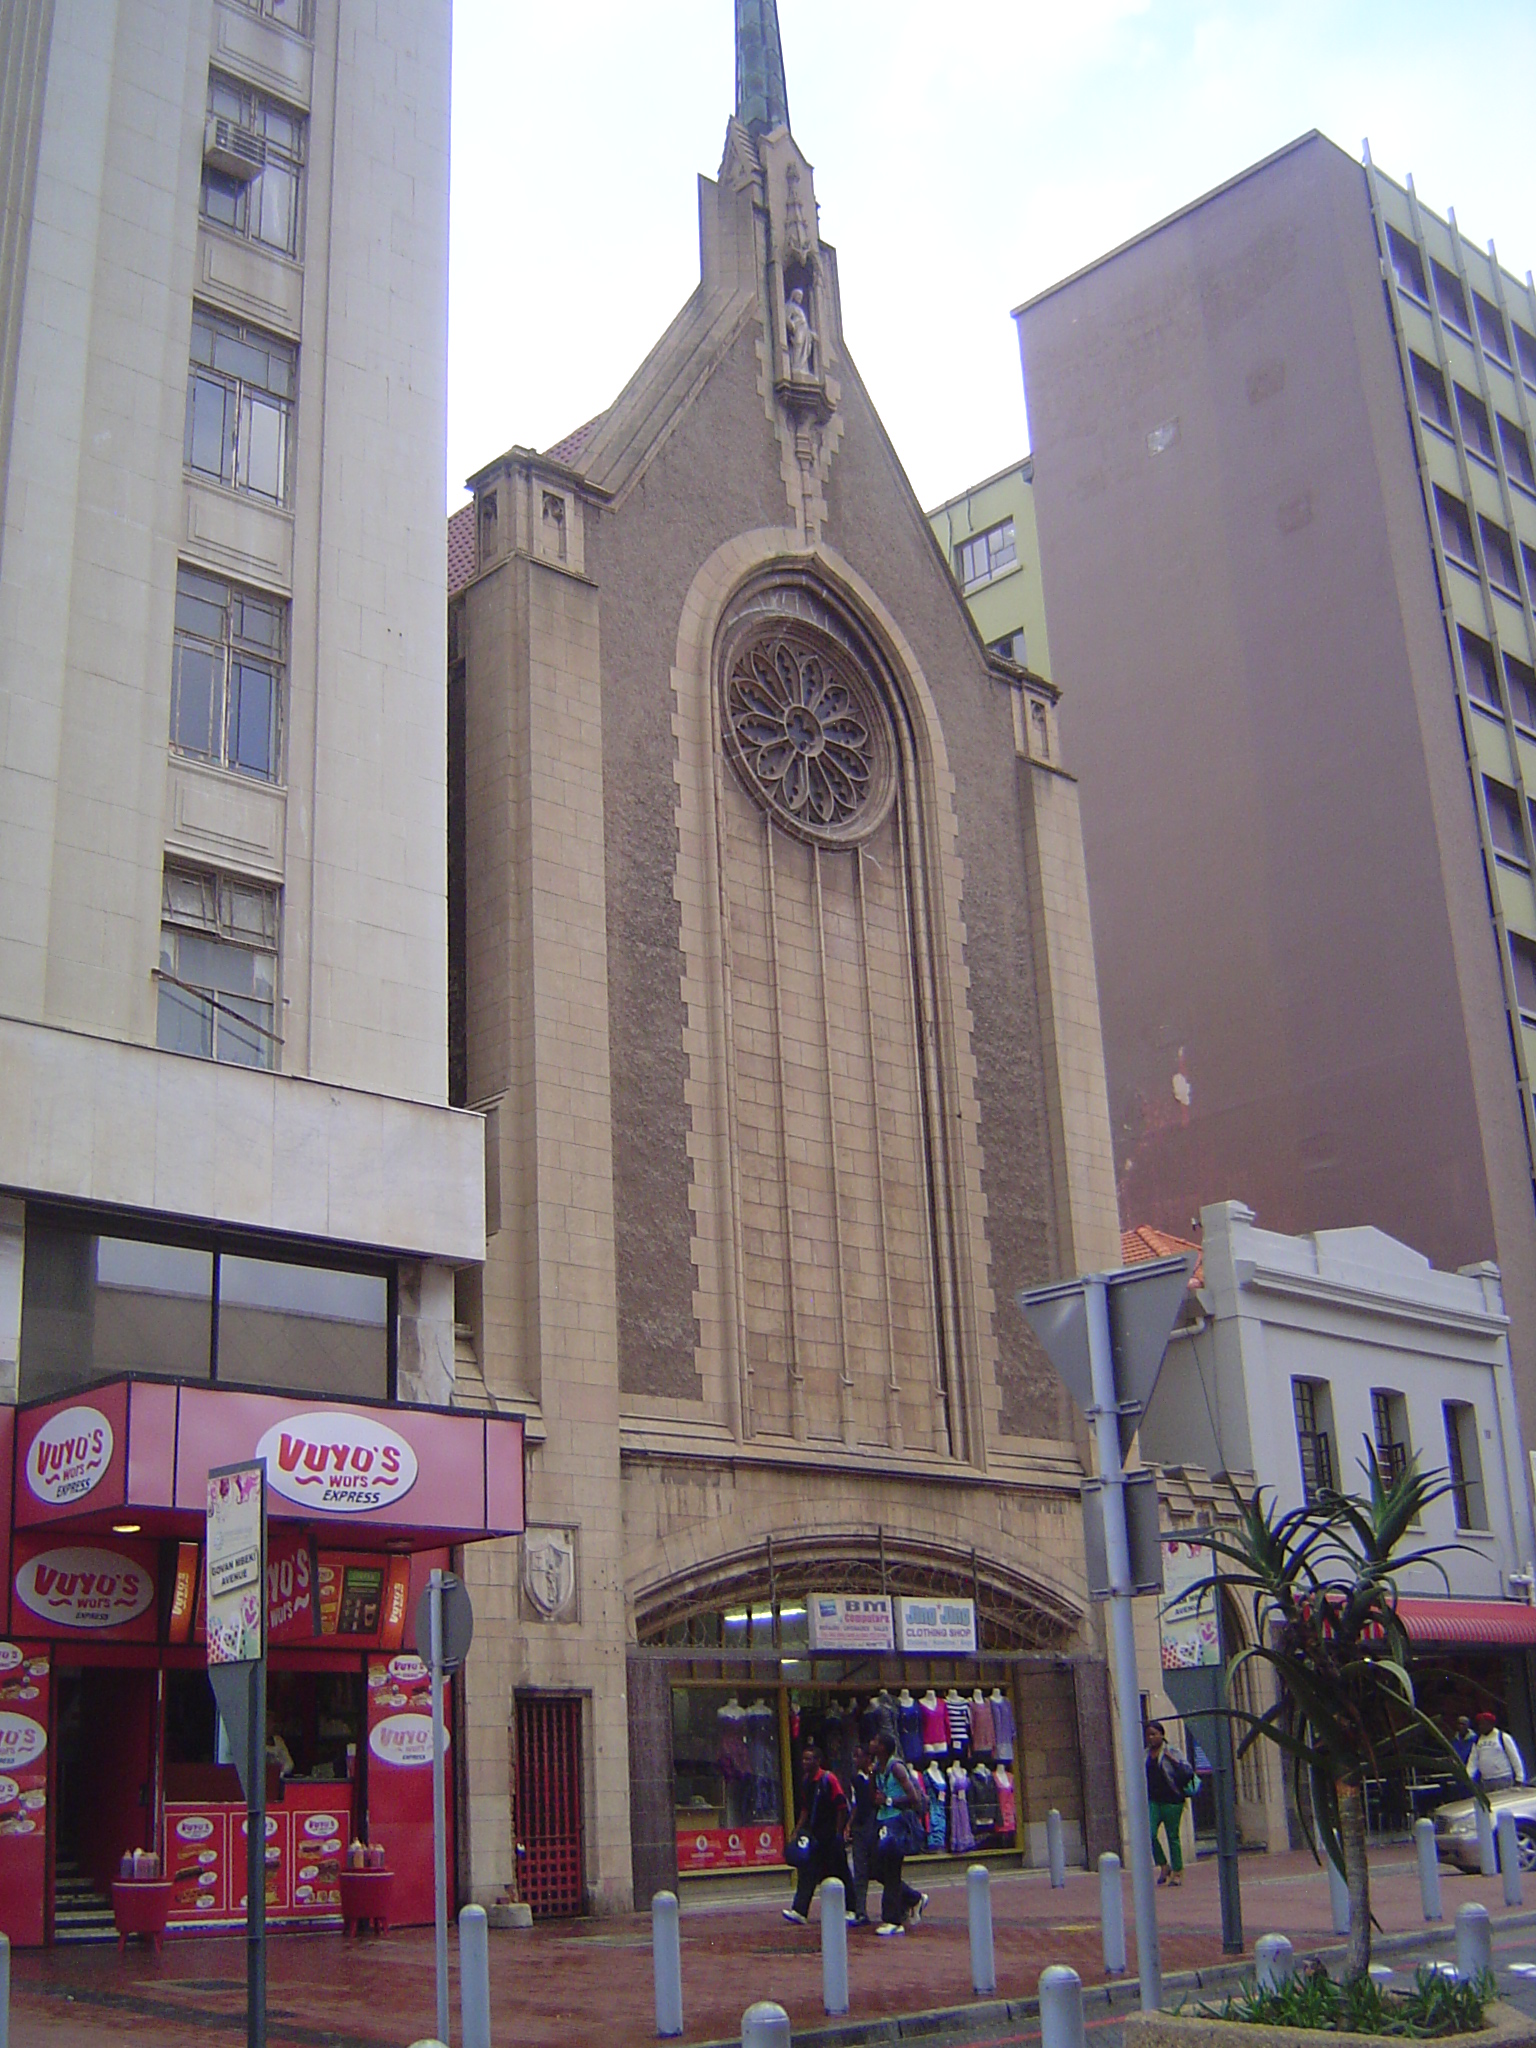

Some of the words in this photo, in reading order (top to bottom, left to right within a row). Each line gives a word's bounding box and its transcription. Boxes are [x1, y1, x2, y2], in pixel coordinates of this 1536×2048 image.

[38, 1429, 103, 1475] VUYO'S
[278, 1433, 400, 1472] VUYO'S
[56, 1478, 91, 1497] EXPRESS
[329, 1475, 368, 1487] wors
[322, 1490, 381, 1503] EXPRESS
[211, 1560, 234, 1576] GOVAN
[235, 1553, 257, 1567] MBEKI
[268, 1548, 309, 1602] YO'S
[34, 1564, 139, 1596] VUYO'S
[221, 1569, 248, 1586] AVENUE
[906, 1629, 947, 1637] CLOTHING
[949, 1629, 971, 1637] SHOP
